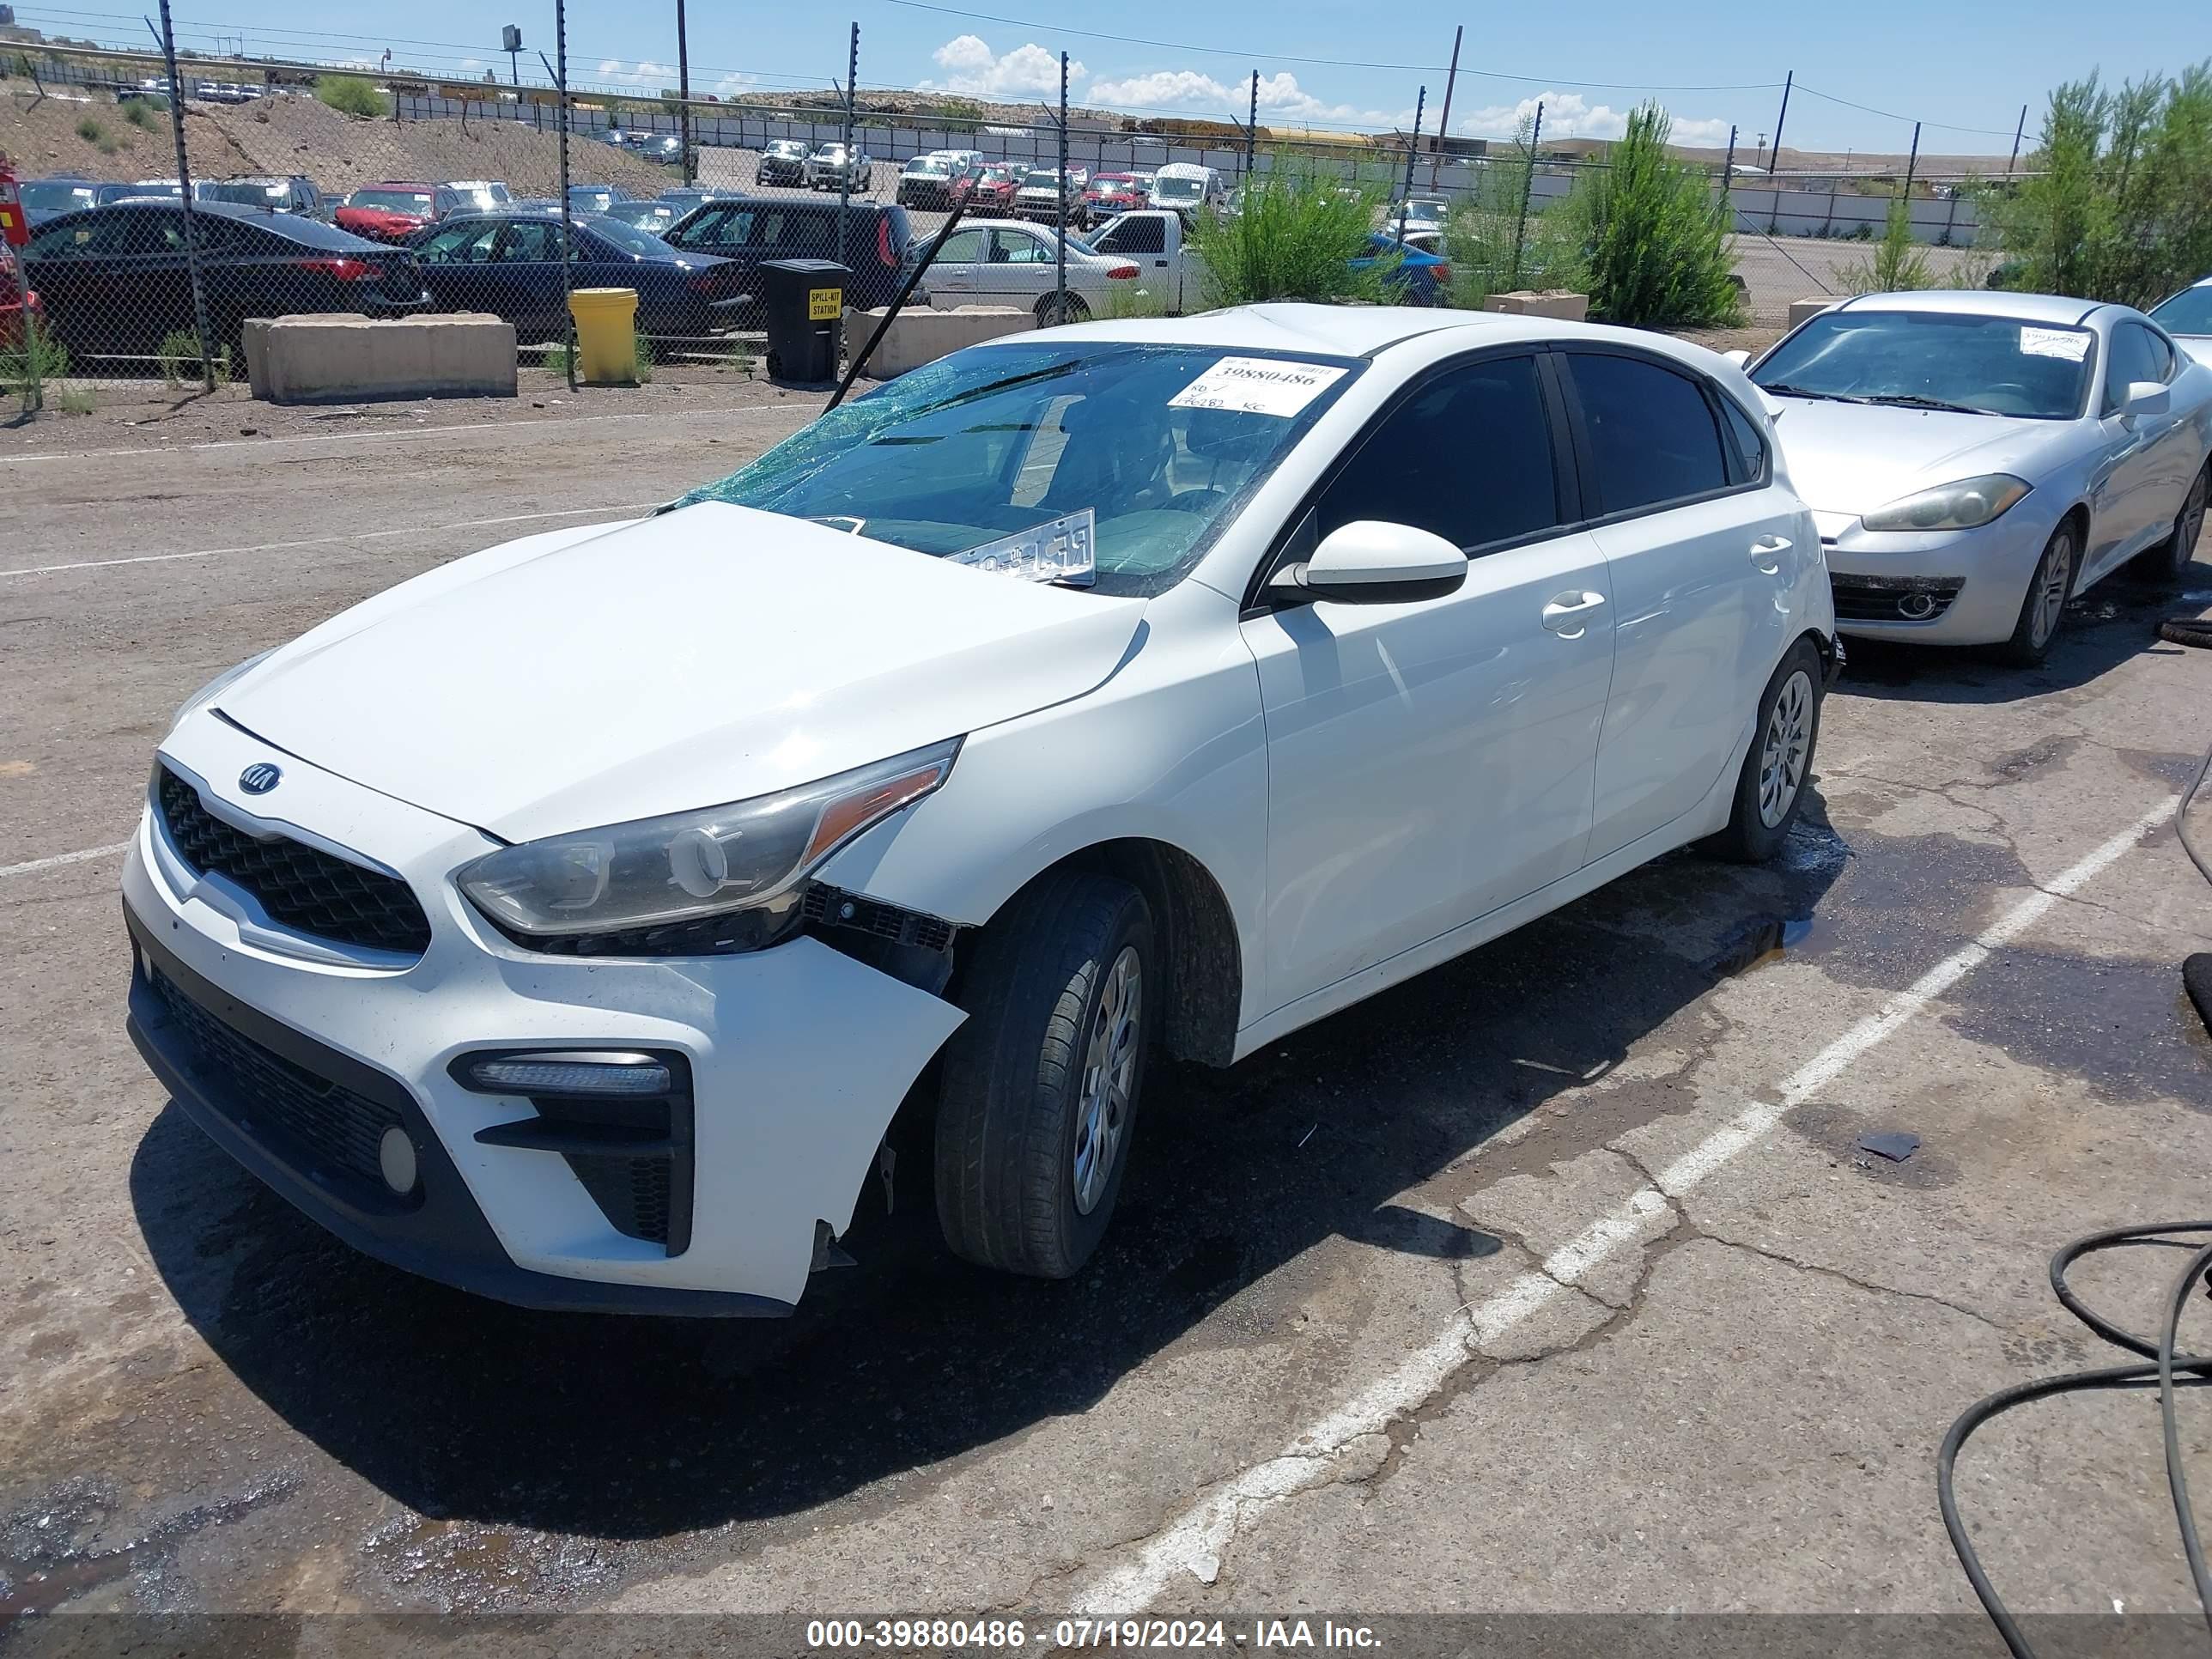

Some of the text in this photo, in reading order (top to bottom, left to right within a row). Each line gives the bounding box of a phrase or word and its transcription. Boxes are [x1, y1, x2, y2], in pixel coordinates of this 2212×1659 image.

[811, 291, 840, 302] SPILL-KIT
[812, 305, 837, 315] STATION
[1215, 367, 1316, 386] 39880486
[240, 763, 275, 790] KIA
